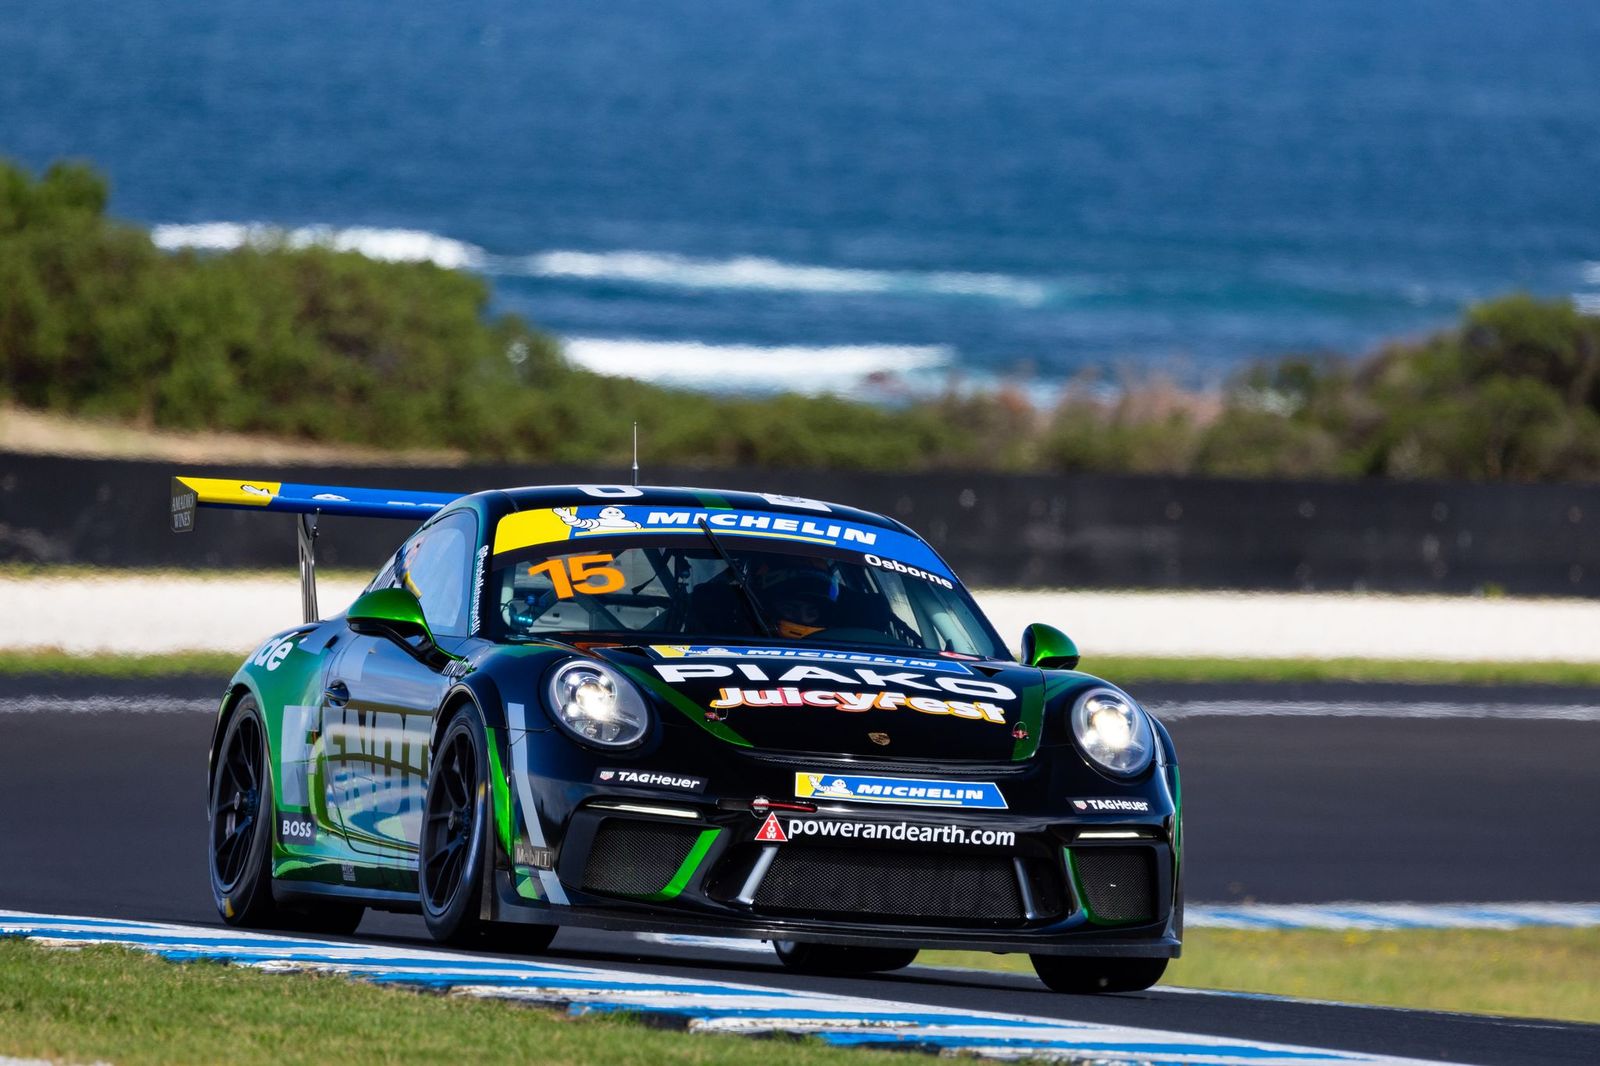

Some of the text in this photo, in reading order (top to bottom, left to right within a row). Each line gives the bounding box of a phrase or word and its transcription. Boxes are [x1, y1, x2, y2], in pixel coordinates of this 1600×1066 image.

[647, 511, 876, 545] MICHELIN
[527, 553, 626, 600] 15
[864, 553, 954, 591] Osborne
[747, 649, 937, 668] MICHELIN
[654, 664, 1016, 700] PIAKO
[856, 784, 984, 801] MICHELIN
[282, 819, 312, 838] BOSS
[765, 819, 777, 839] TOW
[788, 818, 1016, 846] powerandearth.com
